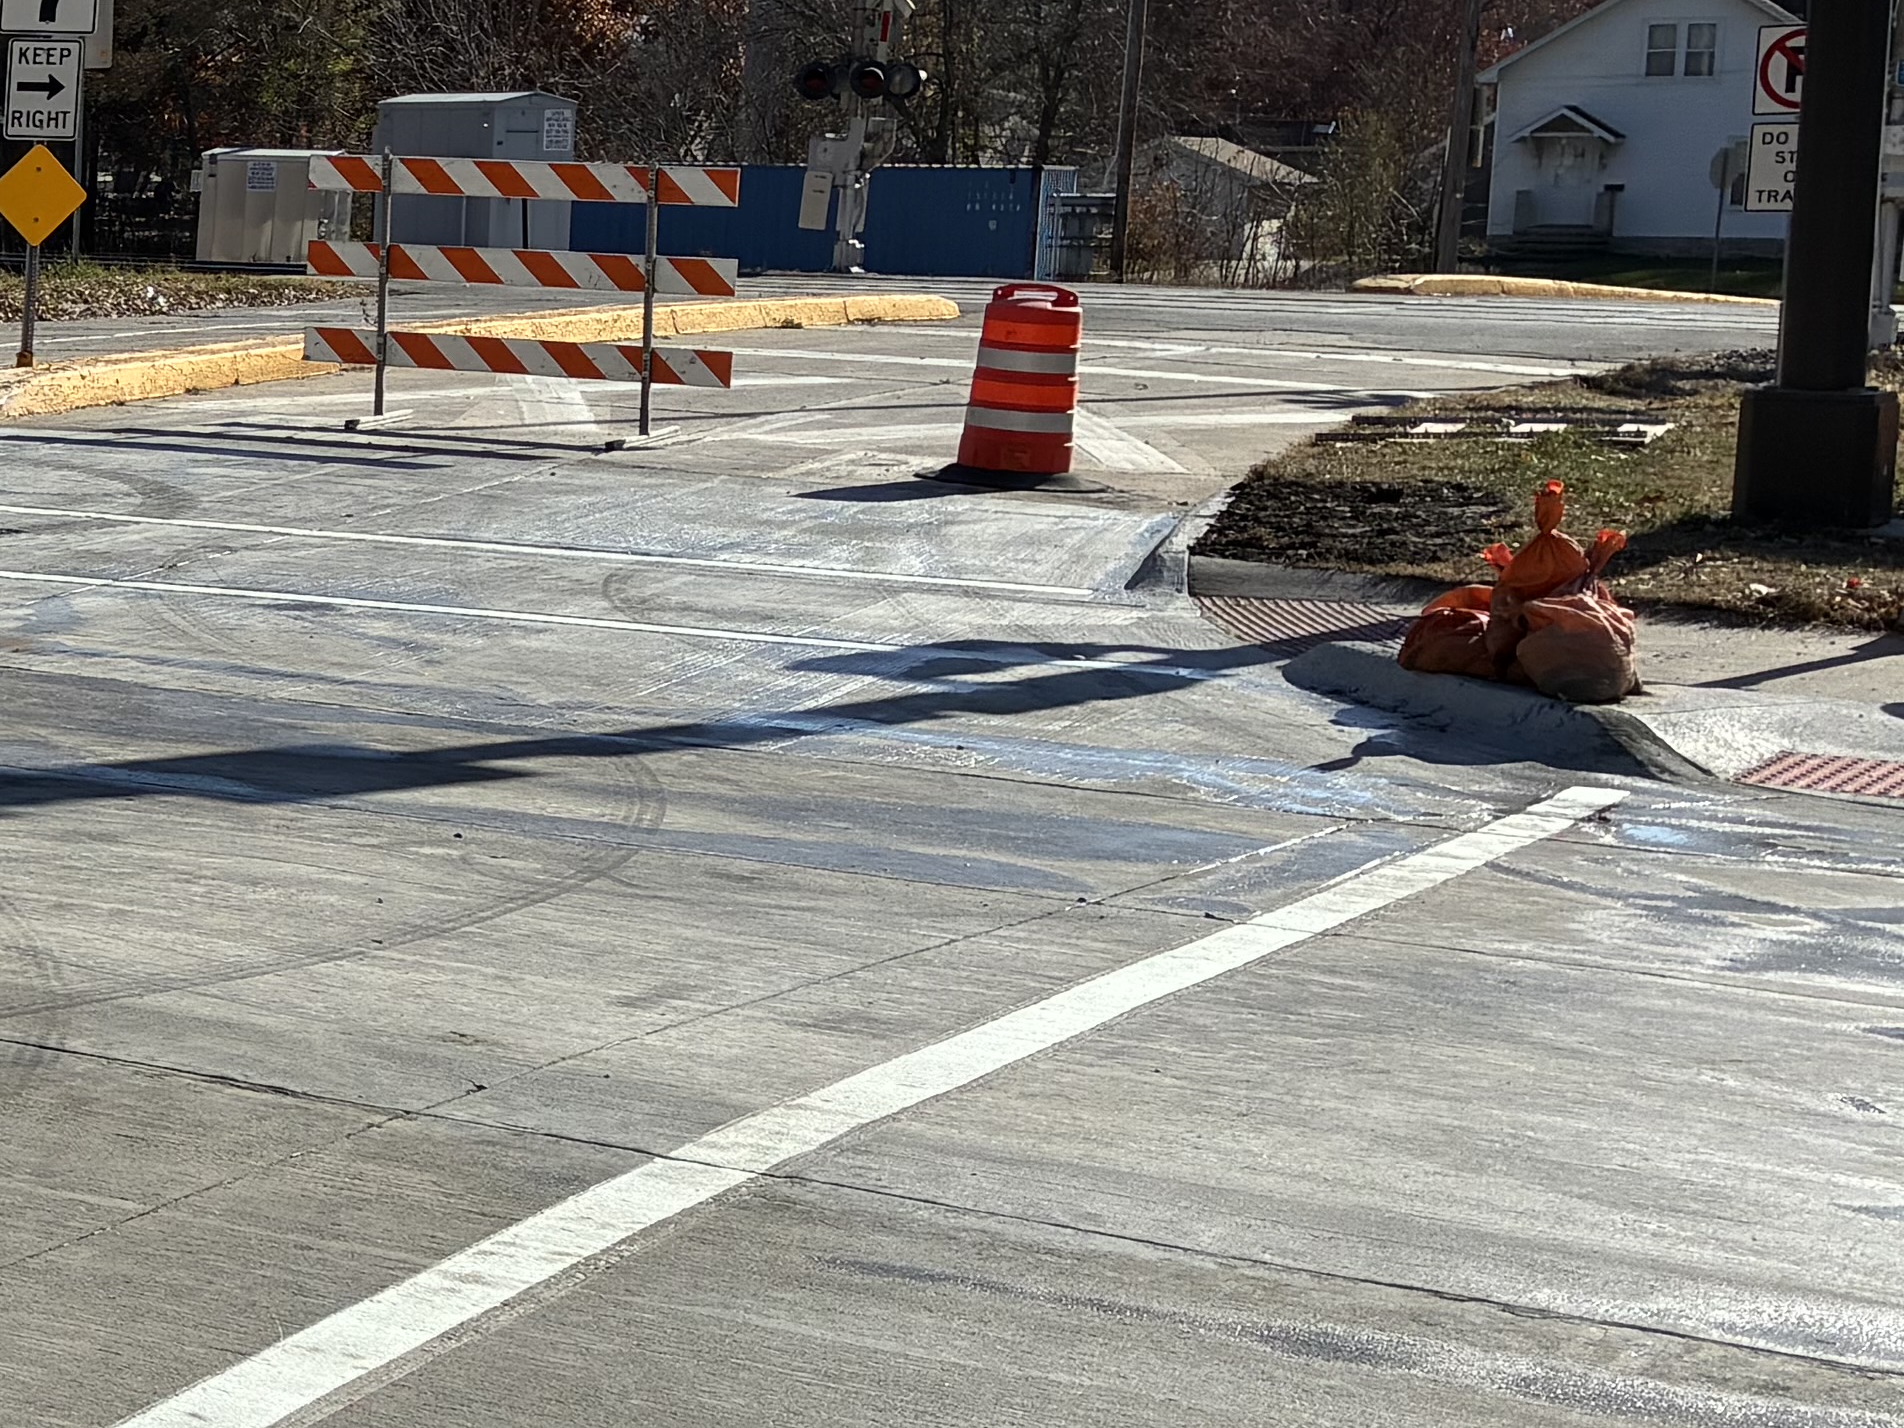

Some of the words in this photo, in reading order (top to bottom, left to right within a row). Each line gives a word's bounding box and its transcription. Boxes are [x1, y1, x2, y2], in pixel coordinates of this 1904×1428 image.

[18, 46, 72, 66] KEEP
[11, 110, 71, 130] RIGHT
[1762, 132, 1789, 145] DO
[1775, 151, 1798, 164] ST
[1755, 190, 1794, 203] TRA
